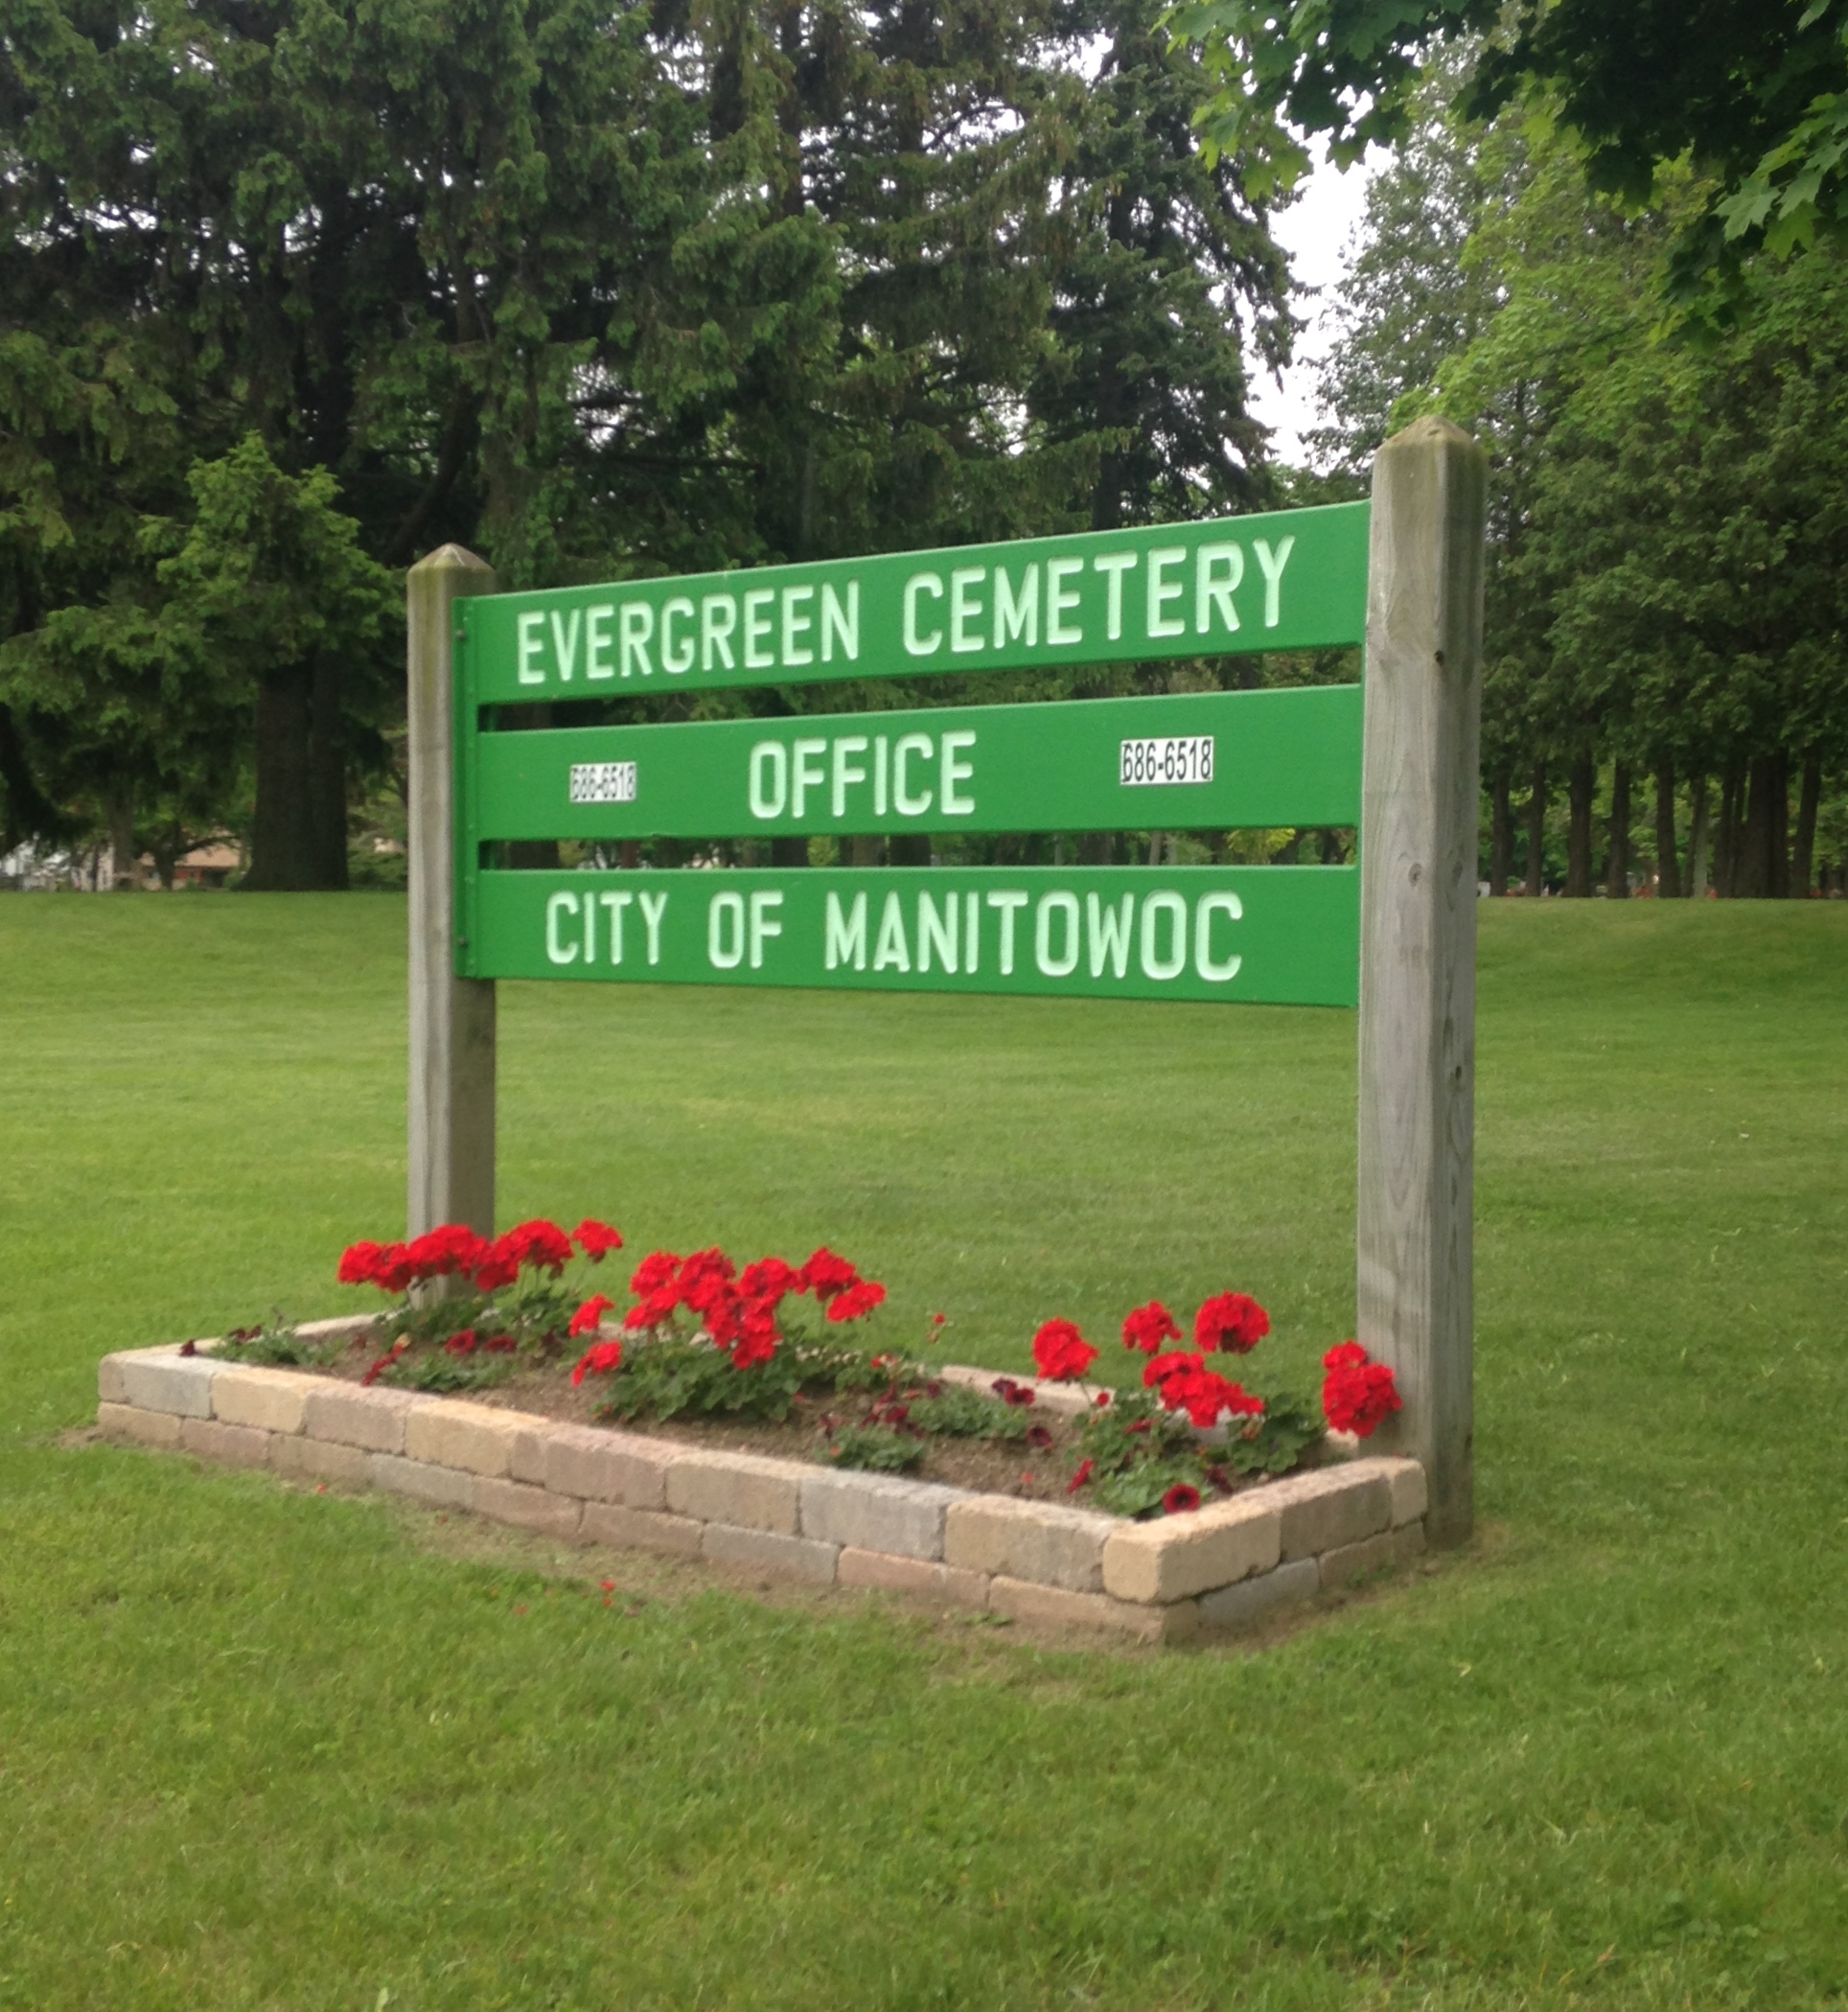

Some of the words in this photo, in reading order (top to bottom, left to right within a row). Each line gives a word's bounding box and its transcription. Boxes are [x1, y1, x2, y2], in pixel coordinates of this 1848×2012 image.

[517, 580, 861, 685] EVERGREEN
[902, 535, 1297, 657] CEMETERY
[572, 764, 635, 800] 686-6518
[749, 729, 977, 820] OFFICE
[1121, 739, 1212, 783] 686-6518
[545, 890, 668, 966] CITY
[707, 890, 784, 969] OF
[824, 890, 1243, 983] MANITOWOC
